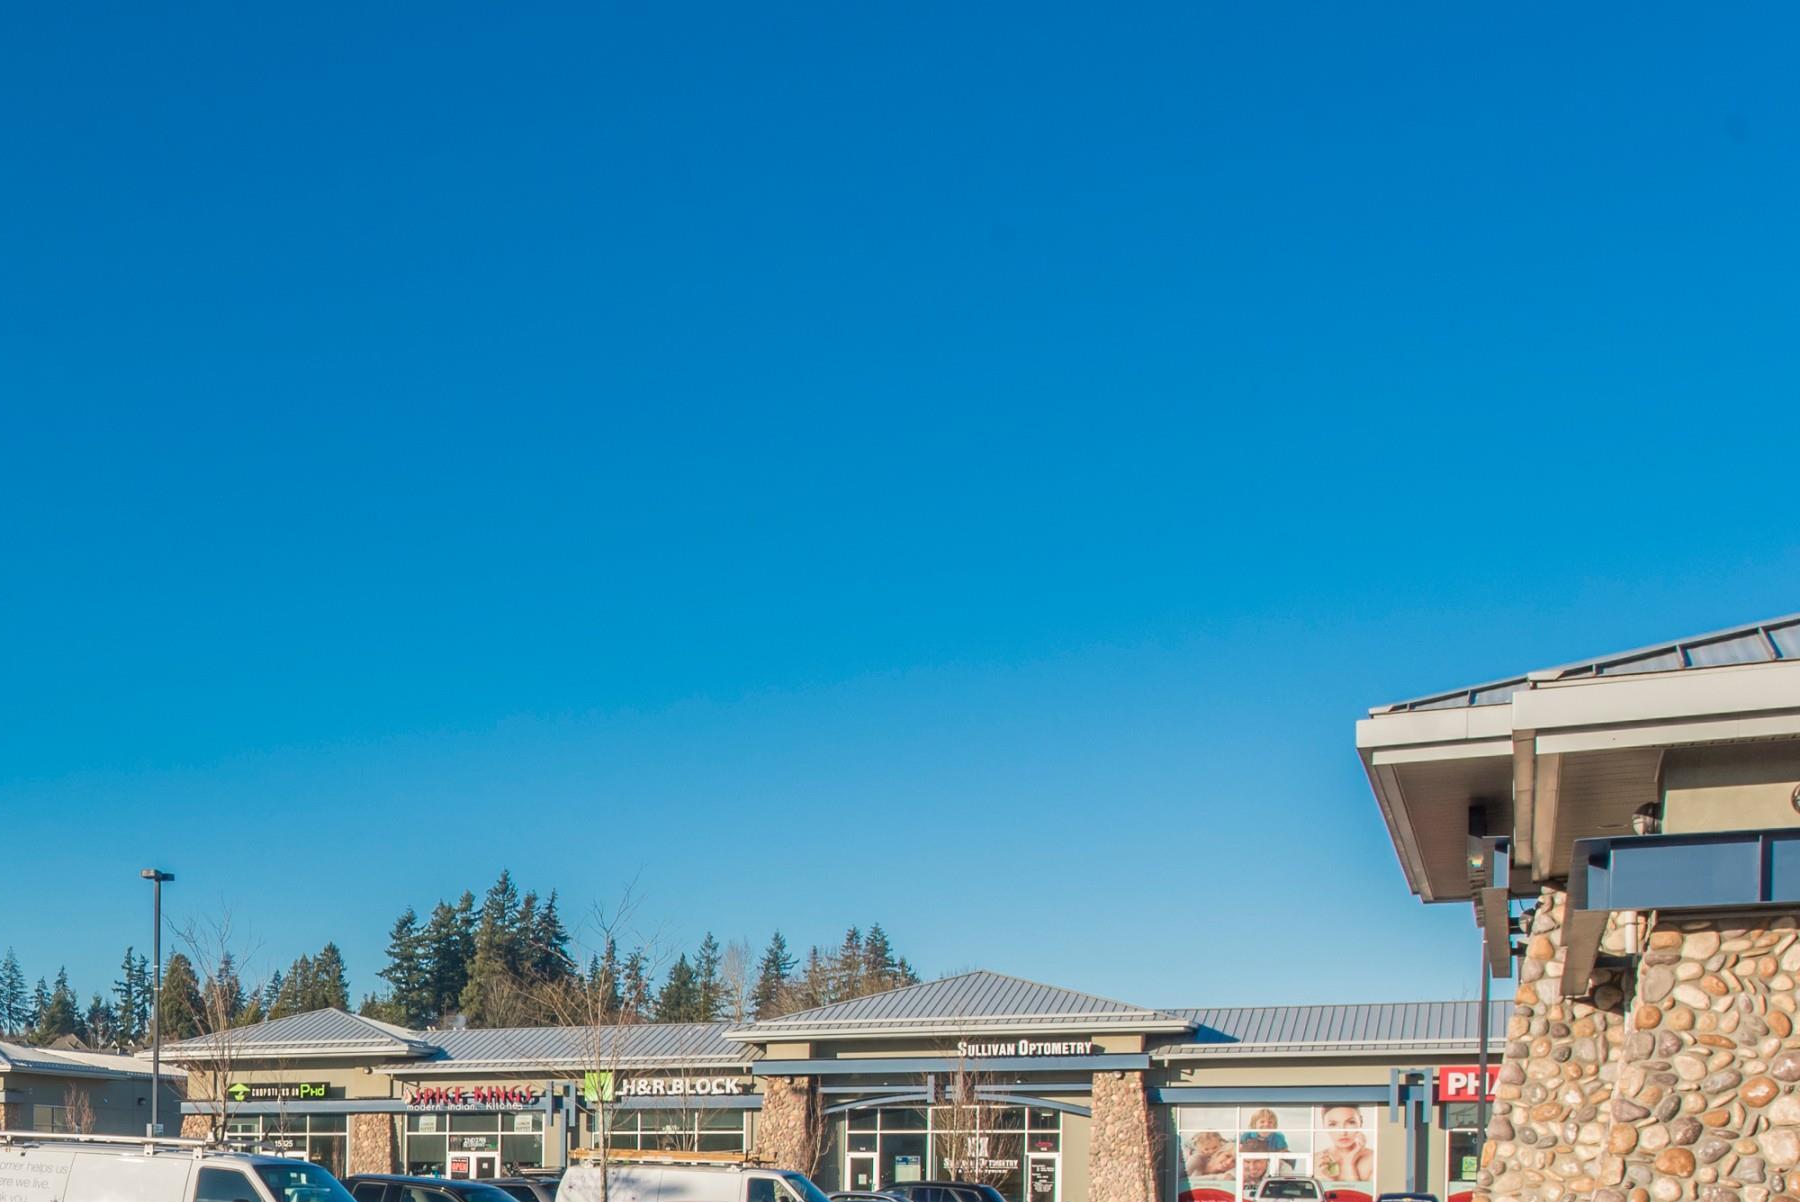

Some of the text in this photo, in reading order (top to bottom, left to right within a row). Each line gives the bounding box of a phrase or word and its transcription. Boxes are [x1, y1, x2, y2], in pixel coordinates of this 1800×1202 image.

[957, 1040, 1093, 1057] SULLIVAN OPTOMETRY
[411, 1084, 532, 1104] SPICE KINGS
[622, 1077, 743, 1095] H&R BLOCK
[27, 1162, 54, 1174] helps
[56, 1164, 69, 1174] us
[15, 1178, 32, 1188] we
